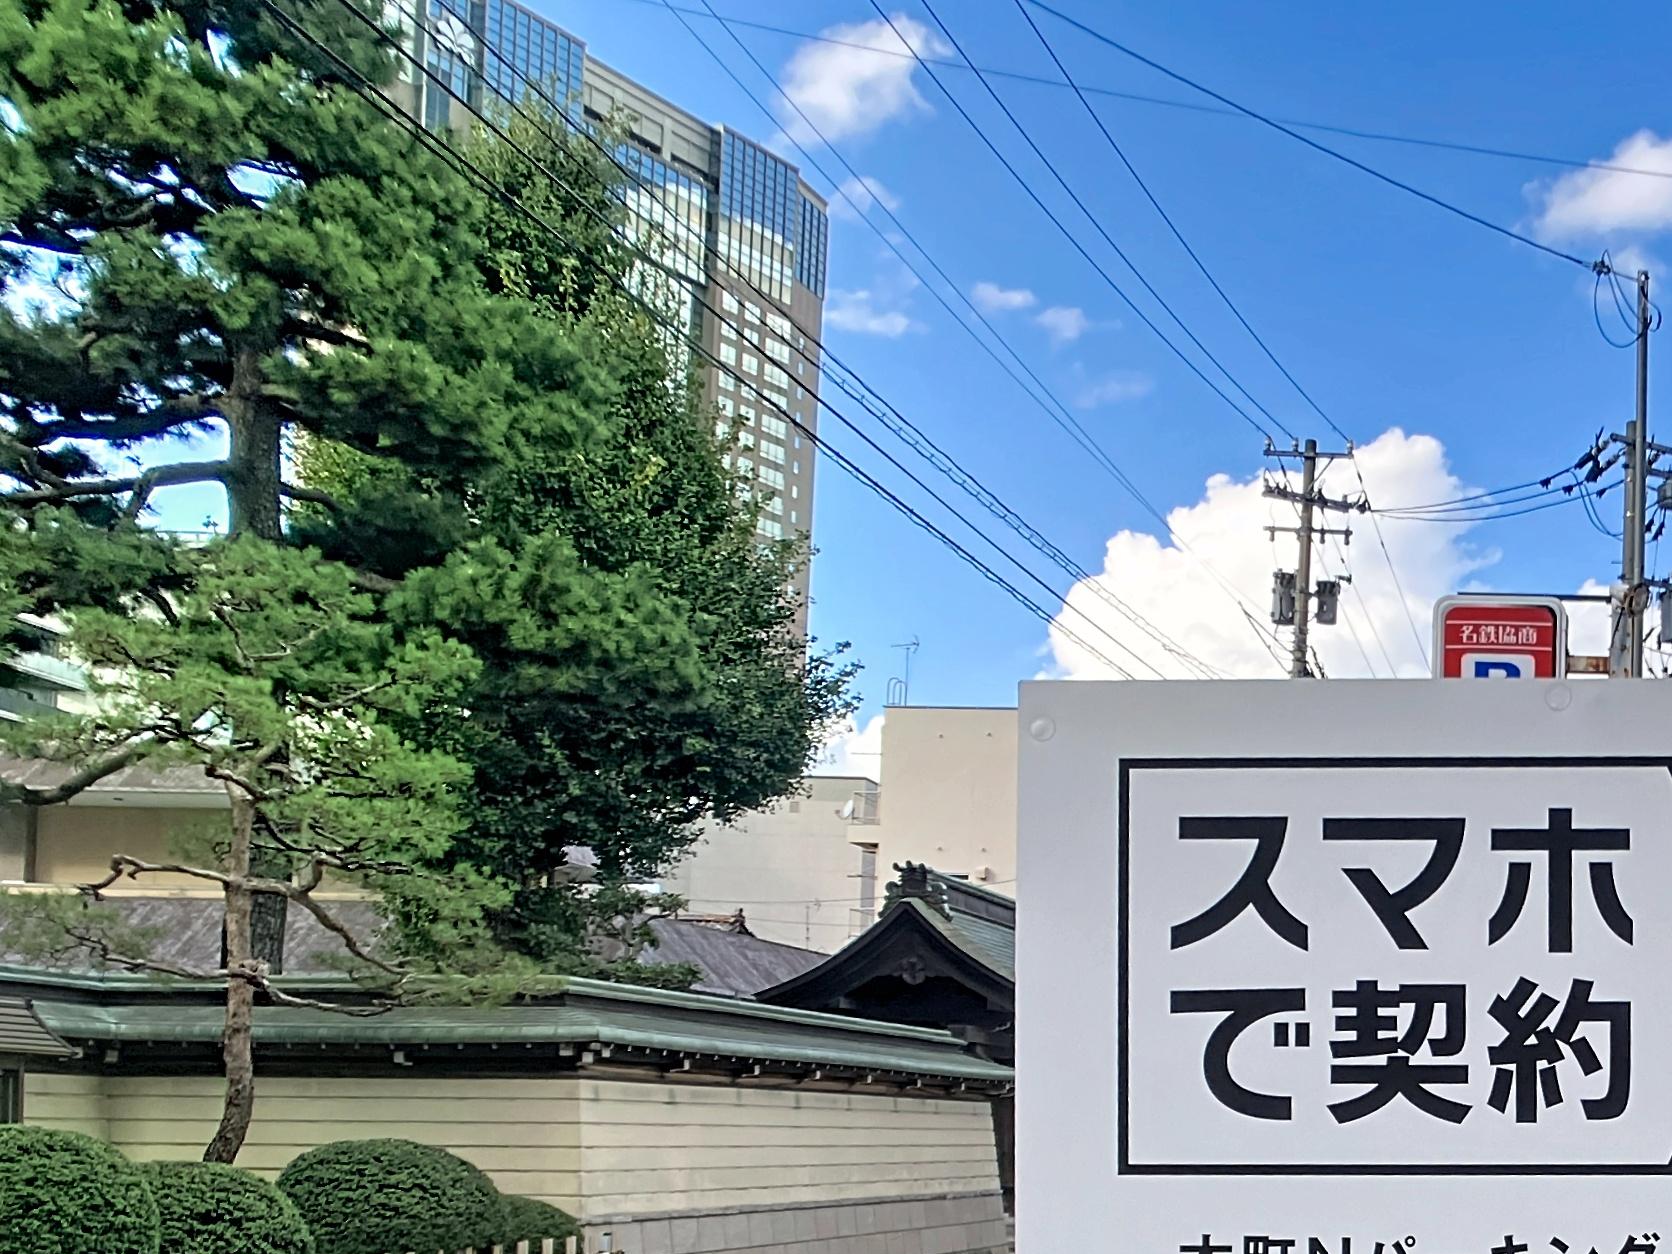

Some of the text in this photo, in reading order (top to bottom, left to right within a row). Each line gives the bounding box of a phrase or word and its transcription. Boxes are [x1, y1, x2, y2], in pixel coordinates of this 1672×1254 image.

[1460, 625, 1537, 645] 名鉄協商
[1170, 807, 1634, 954] スマホ
[1169, 975, 1632, 1125] で契約
